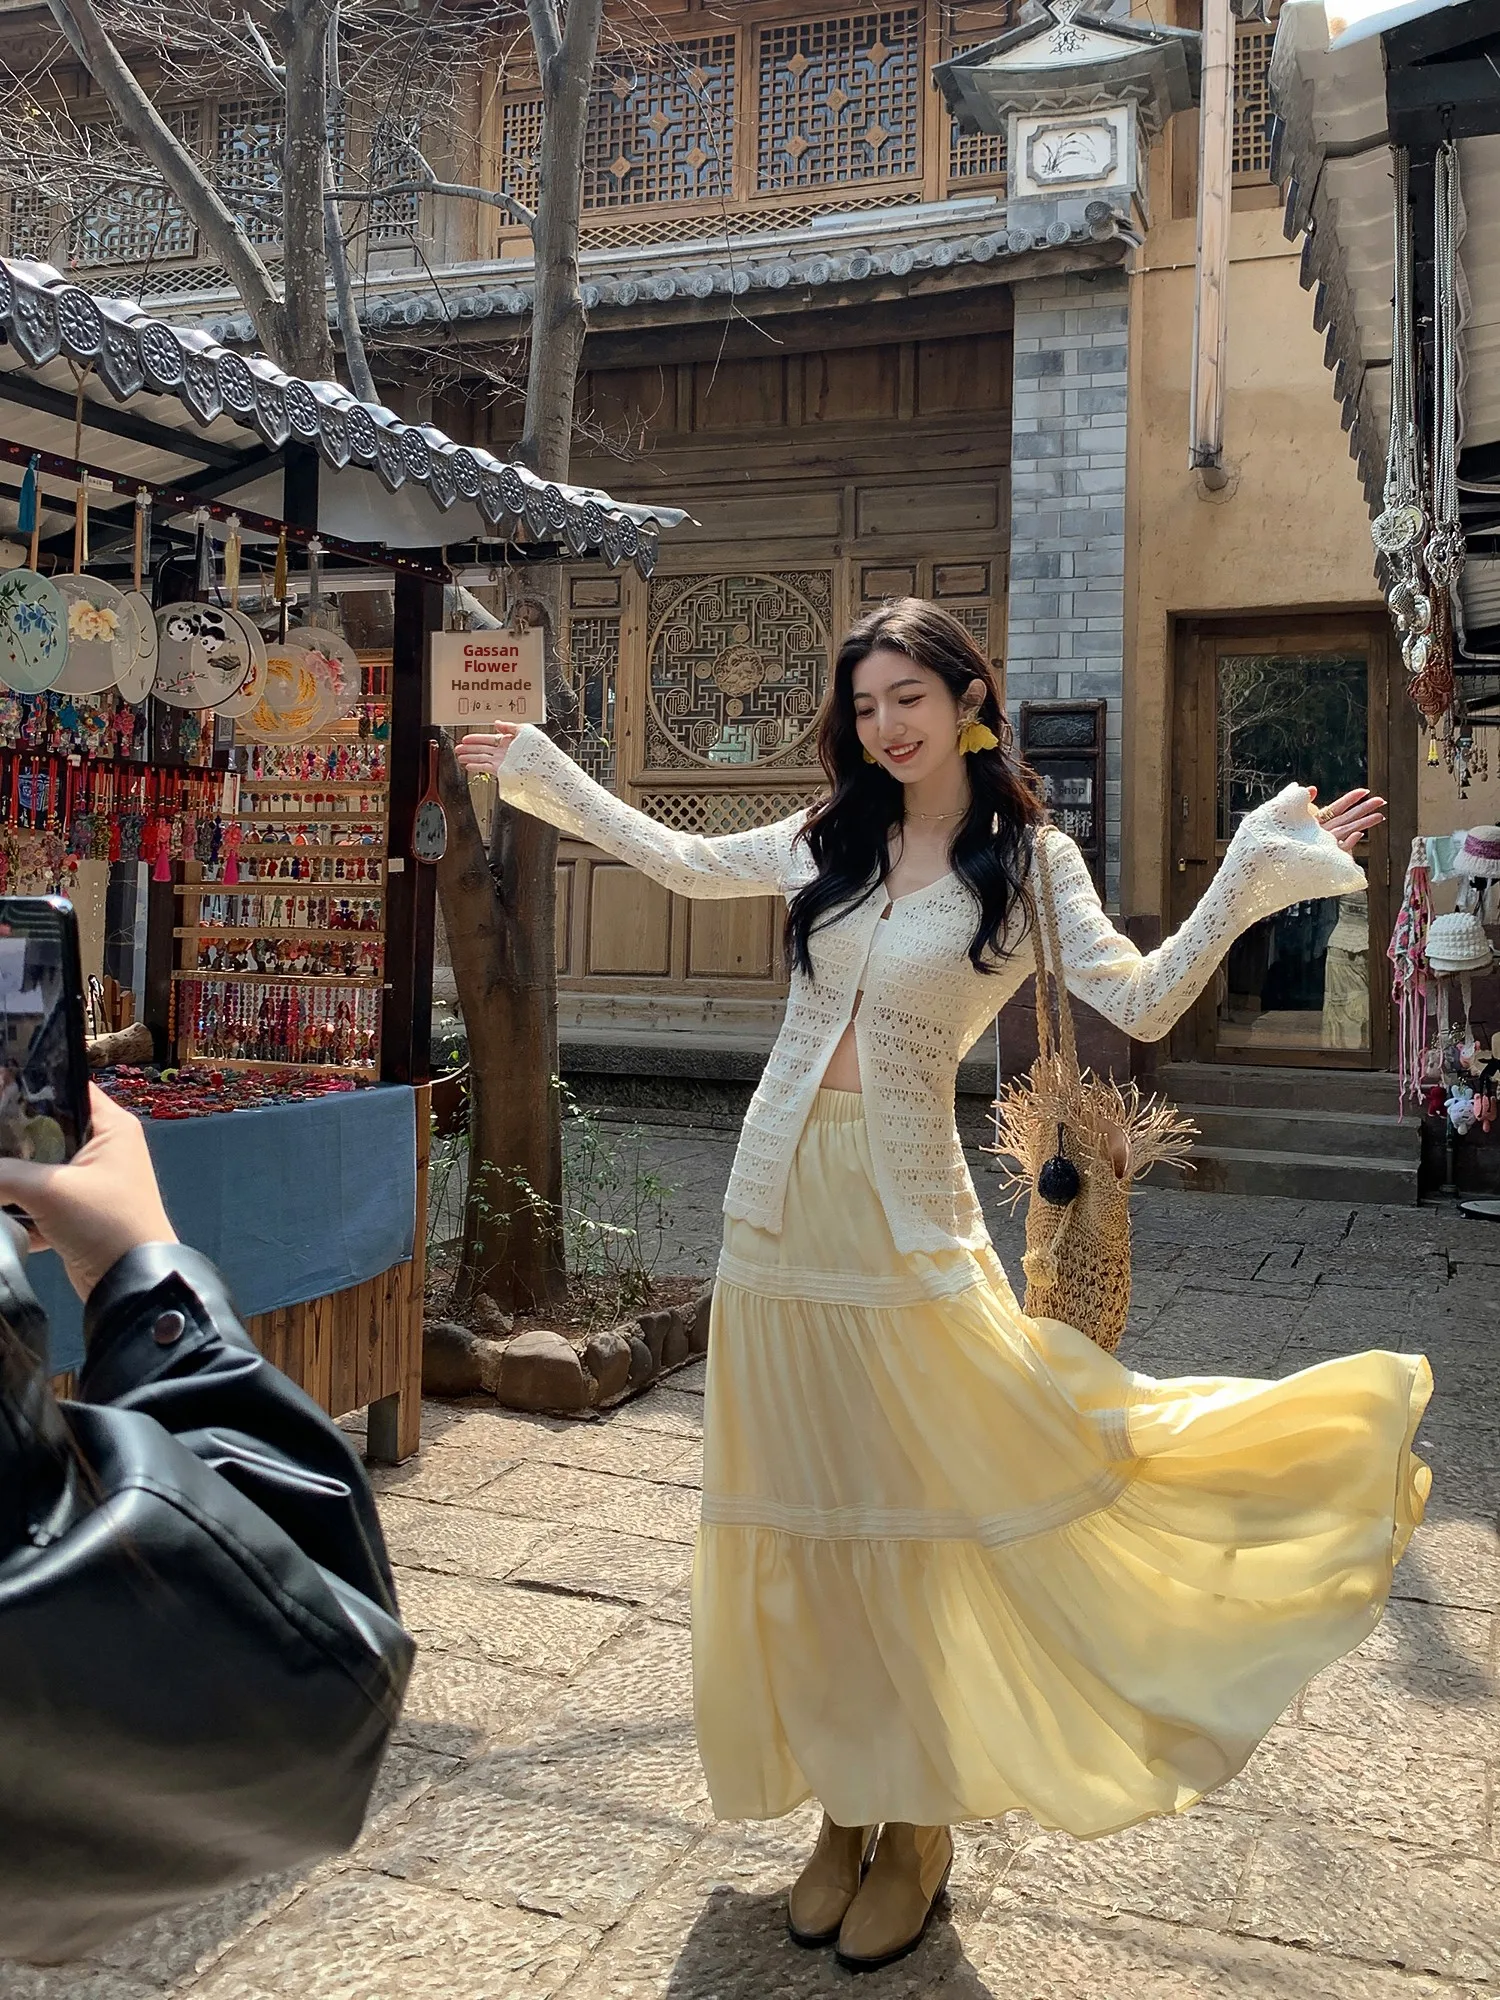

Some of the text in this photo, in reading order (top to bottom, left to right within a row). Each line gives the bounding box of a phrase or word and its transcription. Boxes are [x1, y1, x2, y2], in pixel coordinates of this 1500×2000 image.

[463, 644, 519, 657] Gassan
[464, 659, 518, 673] Flower
[451, 678, 532, 691] Handmade
